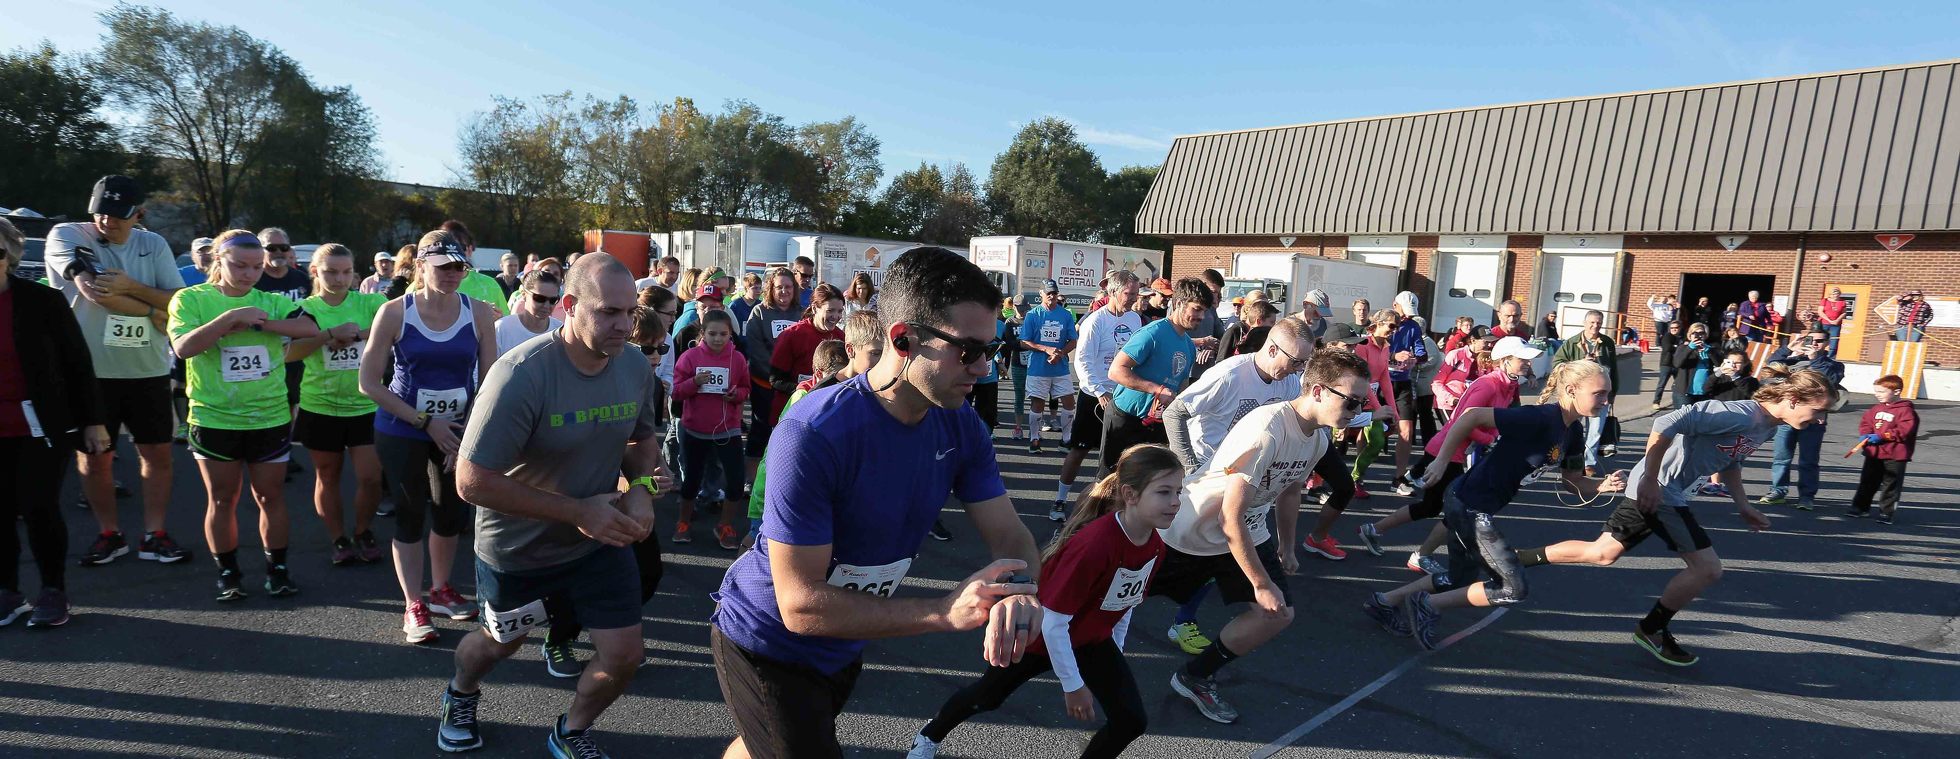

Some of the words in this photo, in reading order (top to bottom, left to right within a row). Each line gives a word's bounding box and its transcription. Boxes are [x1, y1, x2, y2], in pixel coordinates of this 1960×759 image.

[1469, 238, 1475, 246] 3
[1579, 238, 1586, 247] 2
[1728, 237, 1735, 247] 1
[1060, 266, 1095, 277] MISSION
[1057, 276, 1097, 287] CENTRAL
[1066, 297, 1081, 305] GOD'S
[112, 323, 144, 338] 310
[1043, 330, 1057, 338] 326
[330, 346, 359, 361] 233
[229, 354, 263, 371] 234
[705, 374, 724, 386] 86
[425, 398, 458, 414] 294
[588, 401, 637, 421] POTTS
[493, 613, 535, 634] 276
